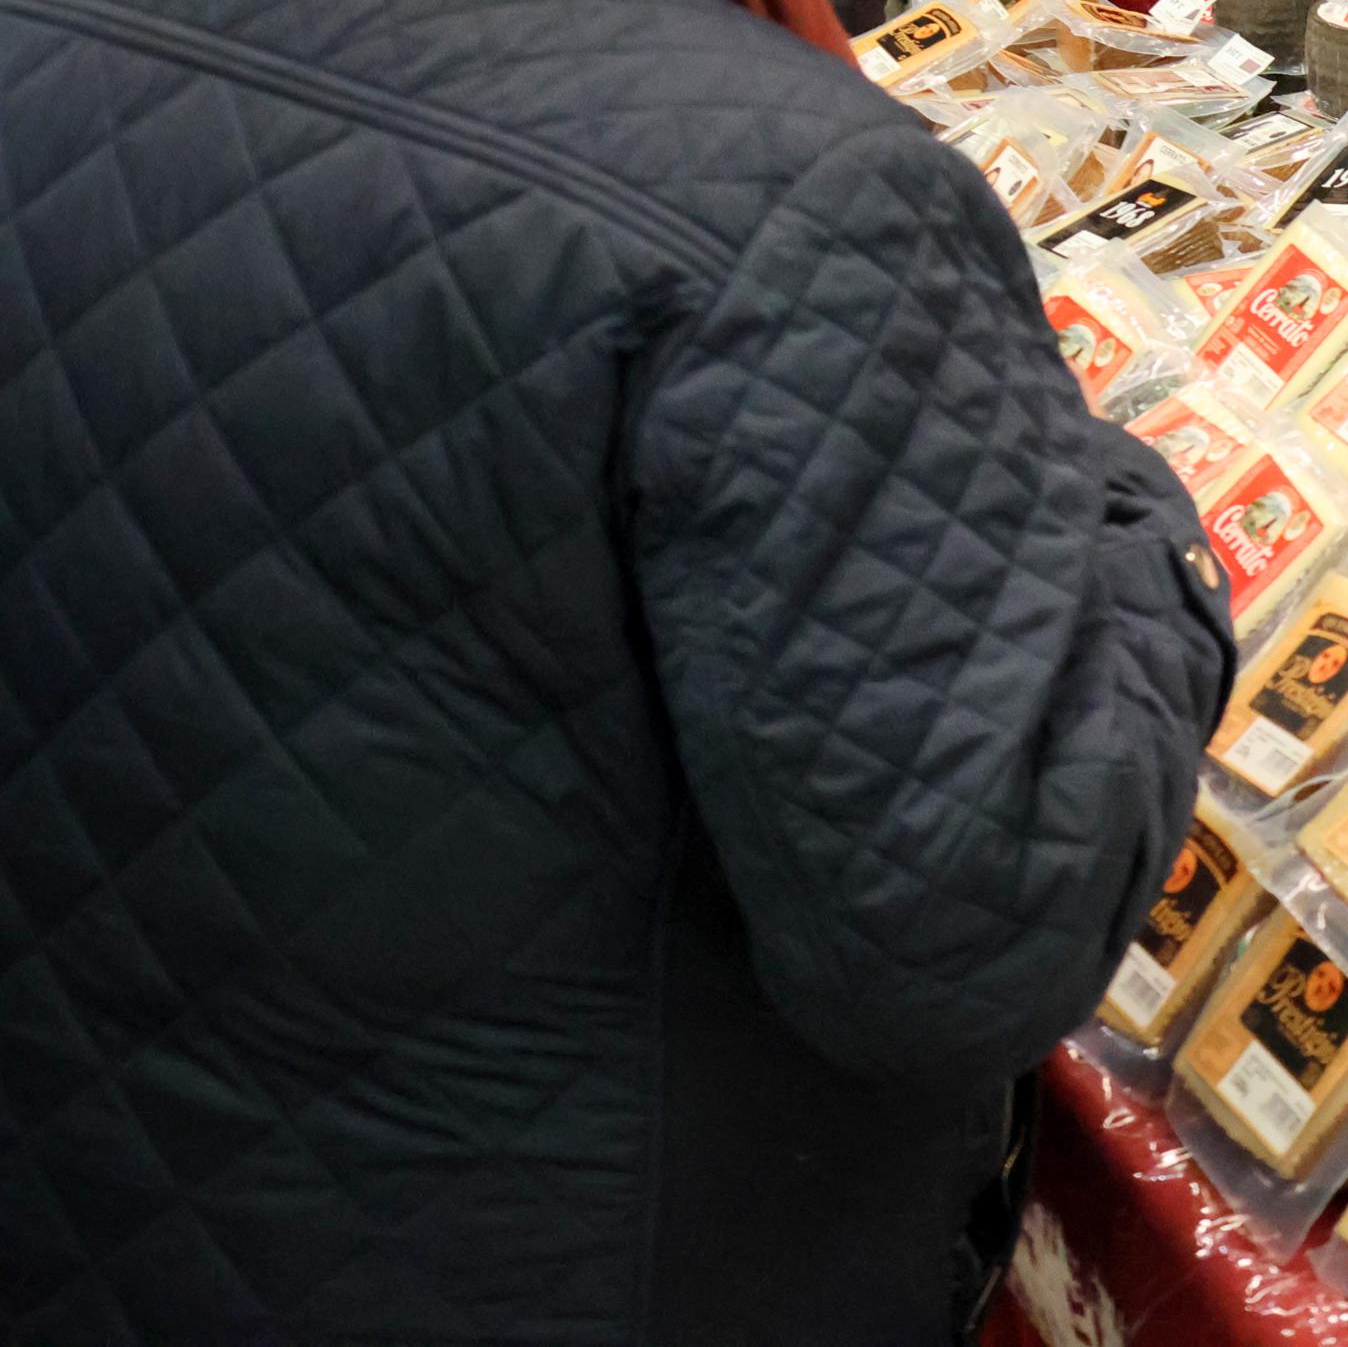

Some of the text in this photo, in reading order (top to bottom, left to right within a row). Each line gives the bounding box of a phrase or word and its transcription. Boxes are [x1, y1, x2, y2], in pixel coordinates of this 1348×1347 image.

[1099, 201, 1155, 228] 1968
[1251, 288, 1314, 348] Cerrato
[1212, 504, 1274, 577] Cerrato
